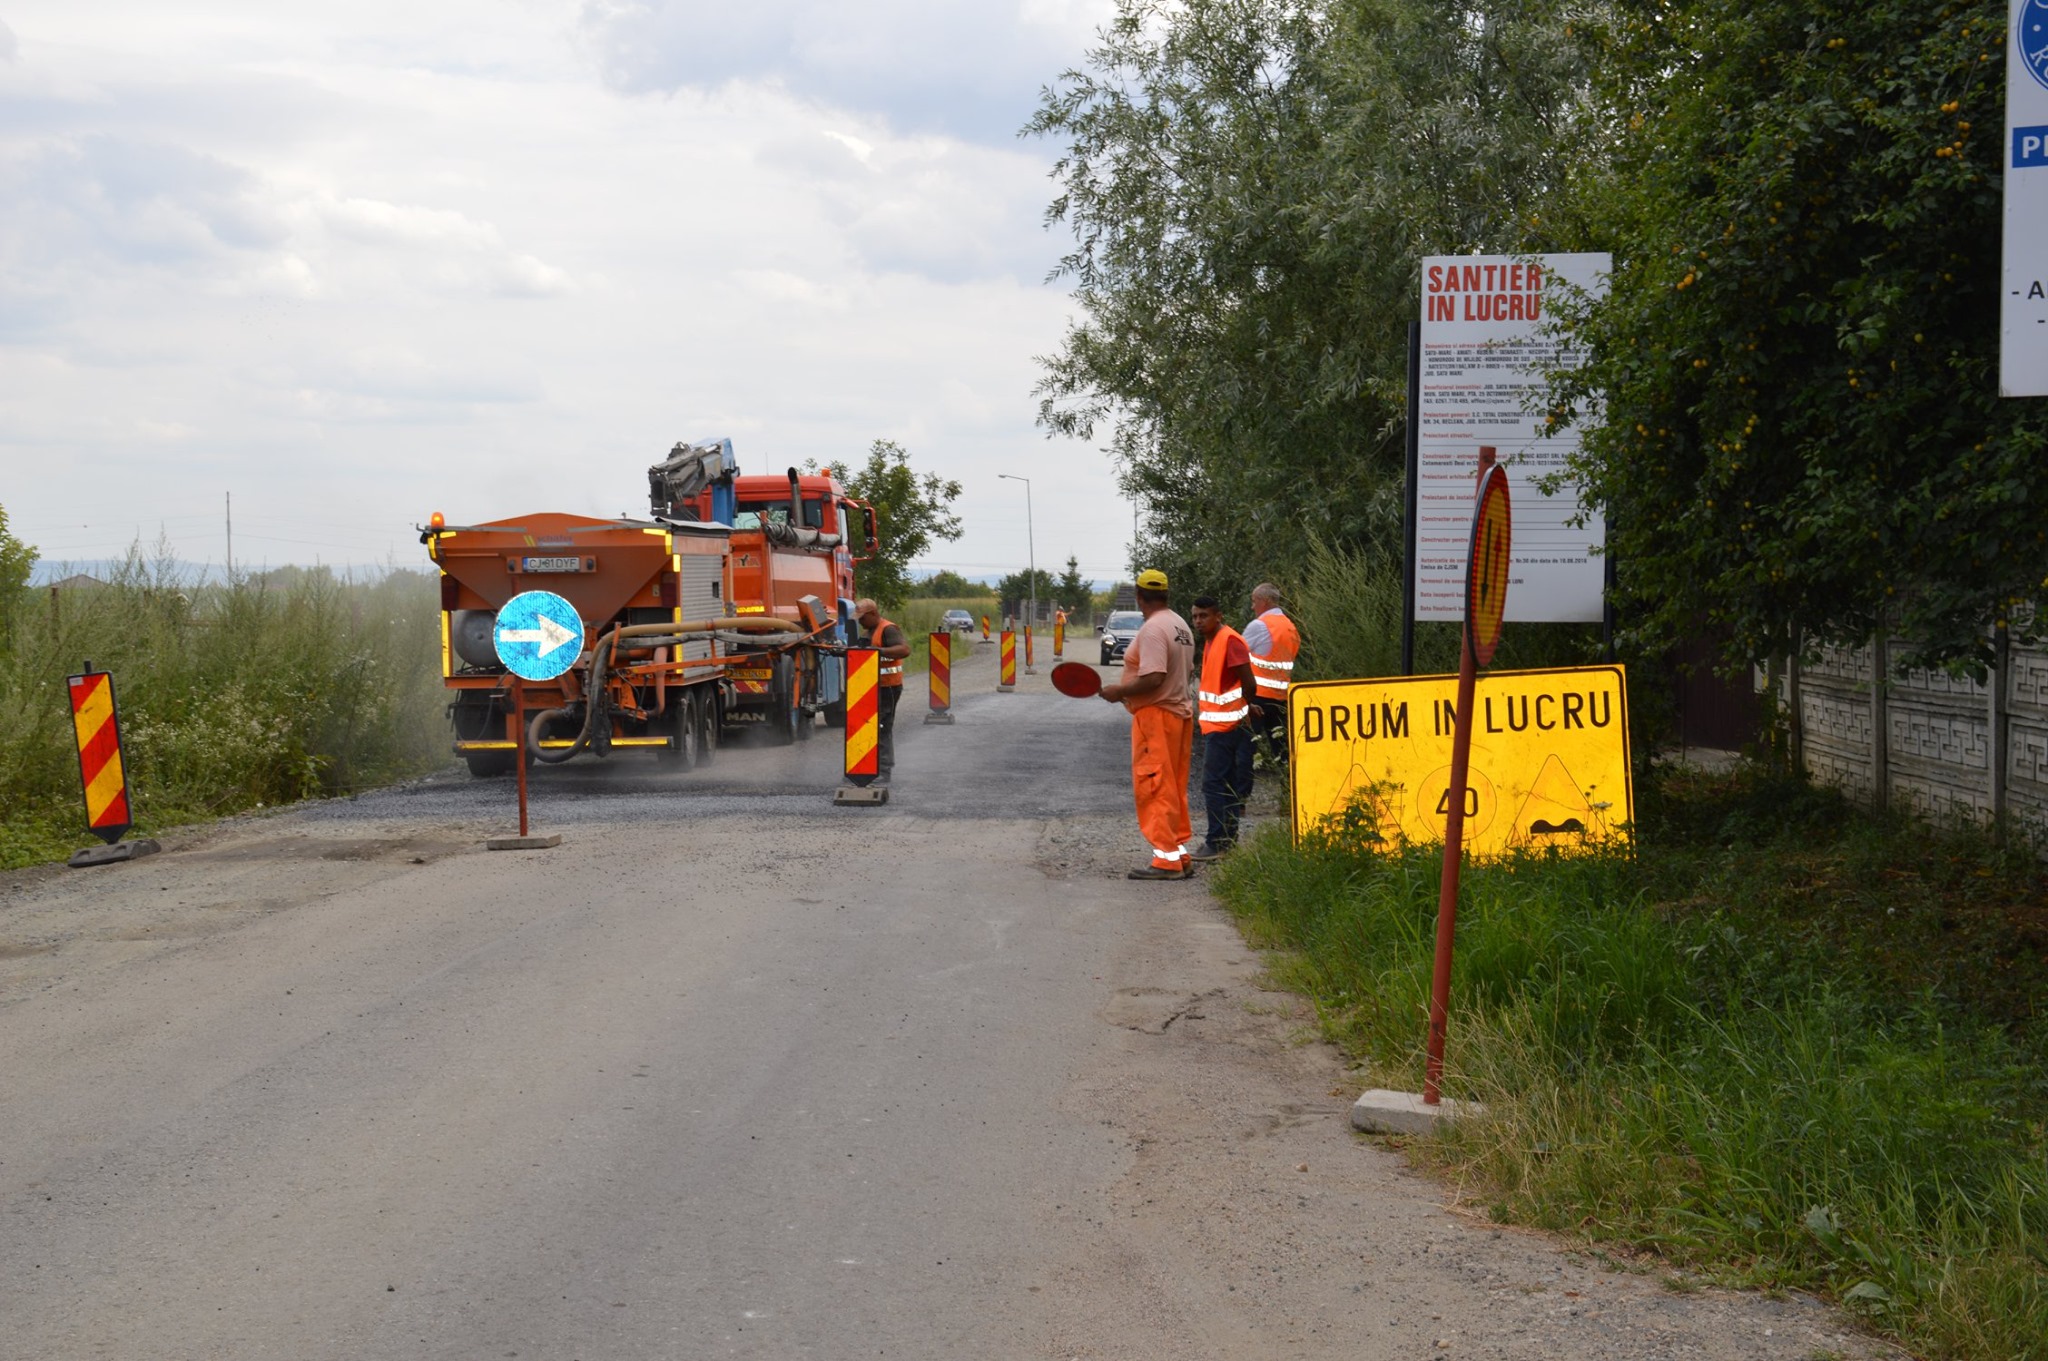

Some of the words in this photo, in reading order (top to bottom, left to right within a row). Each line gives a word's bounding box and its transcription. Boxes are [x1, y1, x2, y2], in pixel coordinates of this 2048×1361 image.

[1428, 264, 1541, 293] SANTIER
[1428, 295, 1456, 322] IN
[1464, 294, 1541, 321] LUCRU
[726, 712, 766, 721] MAN
[1304, 701, 1410, 743] DRUM
[1485, 690, 1612, 734] LUCRU
